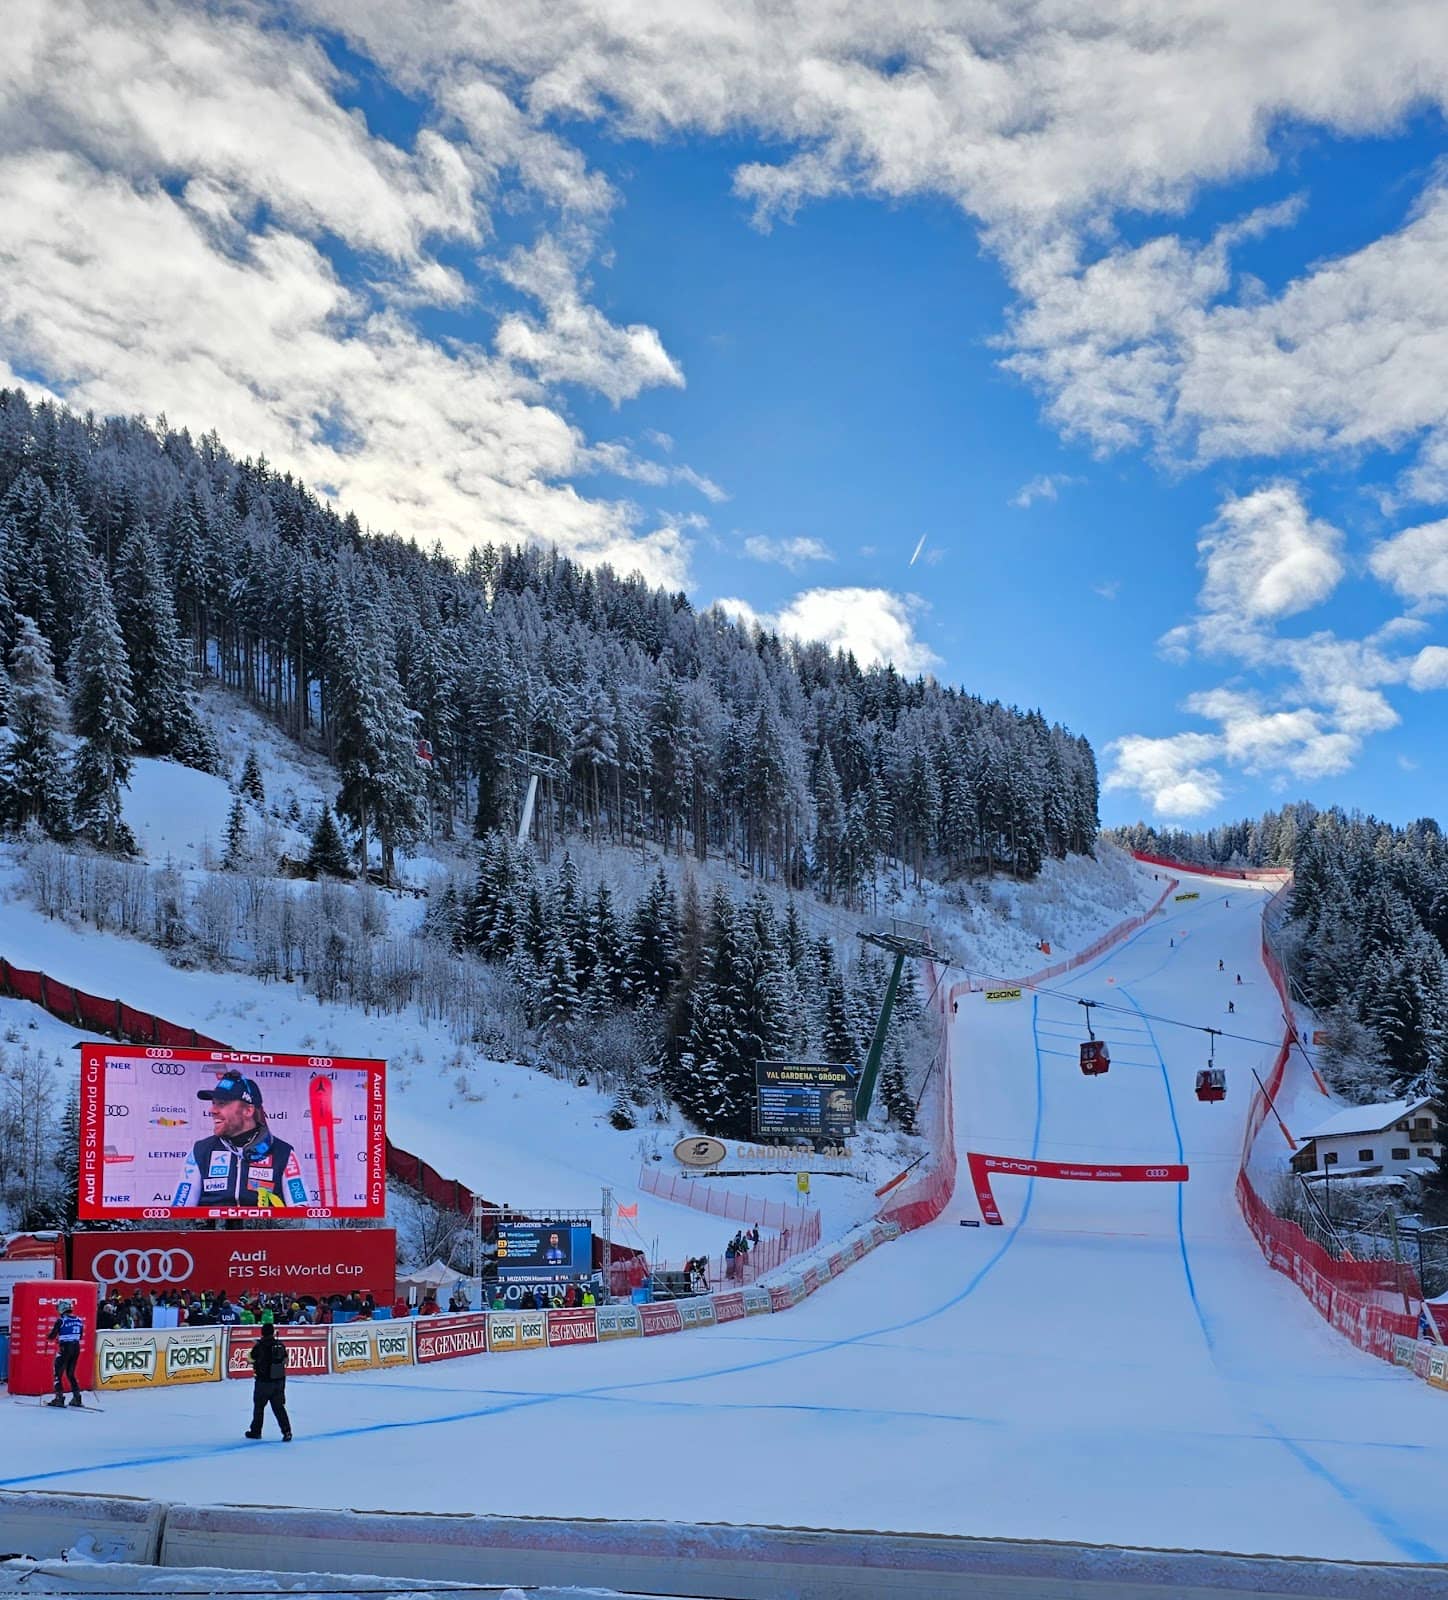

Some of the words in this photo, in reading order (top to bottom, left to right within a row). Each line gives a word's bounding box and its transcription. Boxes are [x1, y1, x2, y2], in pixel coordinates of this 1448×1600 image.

[210, 1052, 273, 1063] e-tron
[87, 1058, 100, 1083] Cup
[255, 1070, 292, 1078] LEITNER
[310, 1071, 338, 1080] Adi
[766, 1071, 780, 1079] VAL
[781, 1072, 813, 1080] GARDENA
[818, 1072, 846, 1081] GRÖDEN
[373, 1072, 383, 1101] Audi
[86, 1086, 98, 1127] World
[373, 1103, 383, 1121] FIS
[85, 1128, 97, 1148] Ski
[373, 1124, 383, 1141] Ski
[85, 1150, 96, 1170] FIS
[372, 1143, 383, 1179] World
[736, 1145, 815, 1160] CANDIDATE
[252, 1169, 270, 1178] DNB
[985, 1159, 1038, 1172] e-tron
[84, 1173, 96, 1205] Audi
[206, 1183, 226, 1191] KPMG
[371, 1181, 382, 1205] Cup
[208, 1208, 272, 1217] e-tron
[229, 1250, 267, 1261] Audi
[228, 1266, 254, 1278] FIS
[259, 1265, 281, 1277] Ski
[285, 1264, 331, 1276] World
[335, 1263, 364, 1276] Cup
[495, 1283, 592, 1302] LONGINS
[493, 1325, 515, 1340] FORST
[522, 1323, 541, 1337] FORST
[560, 1321, 596, 1341] GENERALI
[338, 1340, 369, 1357] FORST
[379, 1337, 407, 1353] FORST
[434, 1330, 485, 1355] GENERALI
[105, 1350, 153, 1370] FORST
[169, 1346, 213, 1367] FORST
[286, 1346, 327, 1369] ERALI
